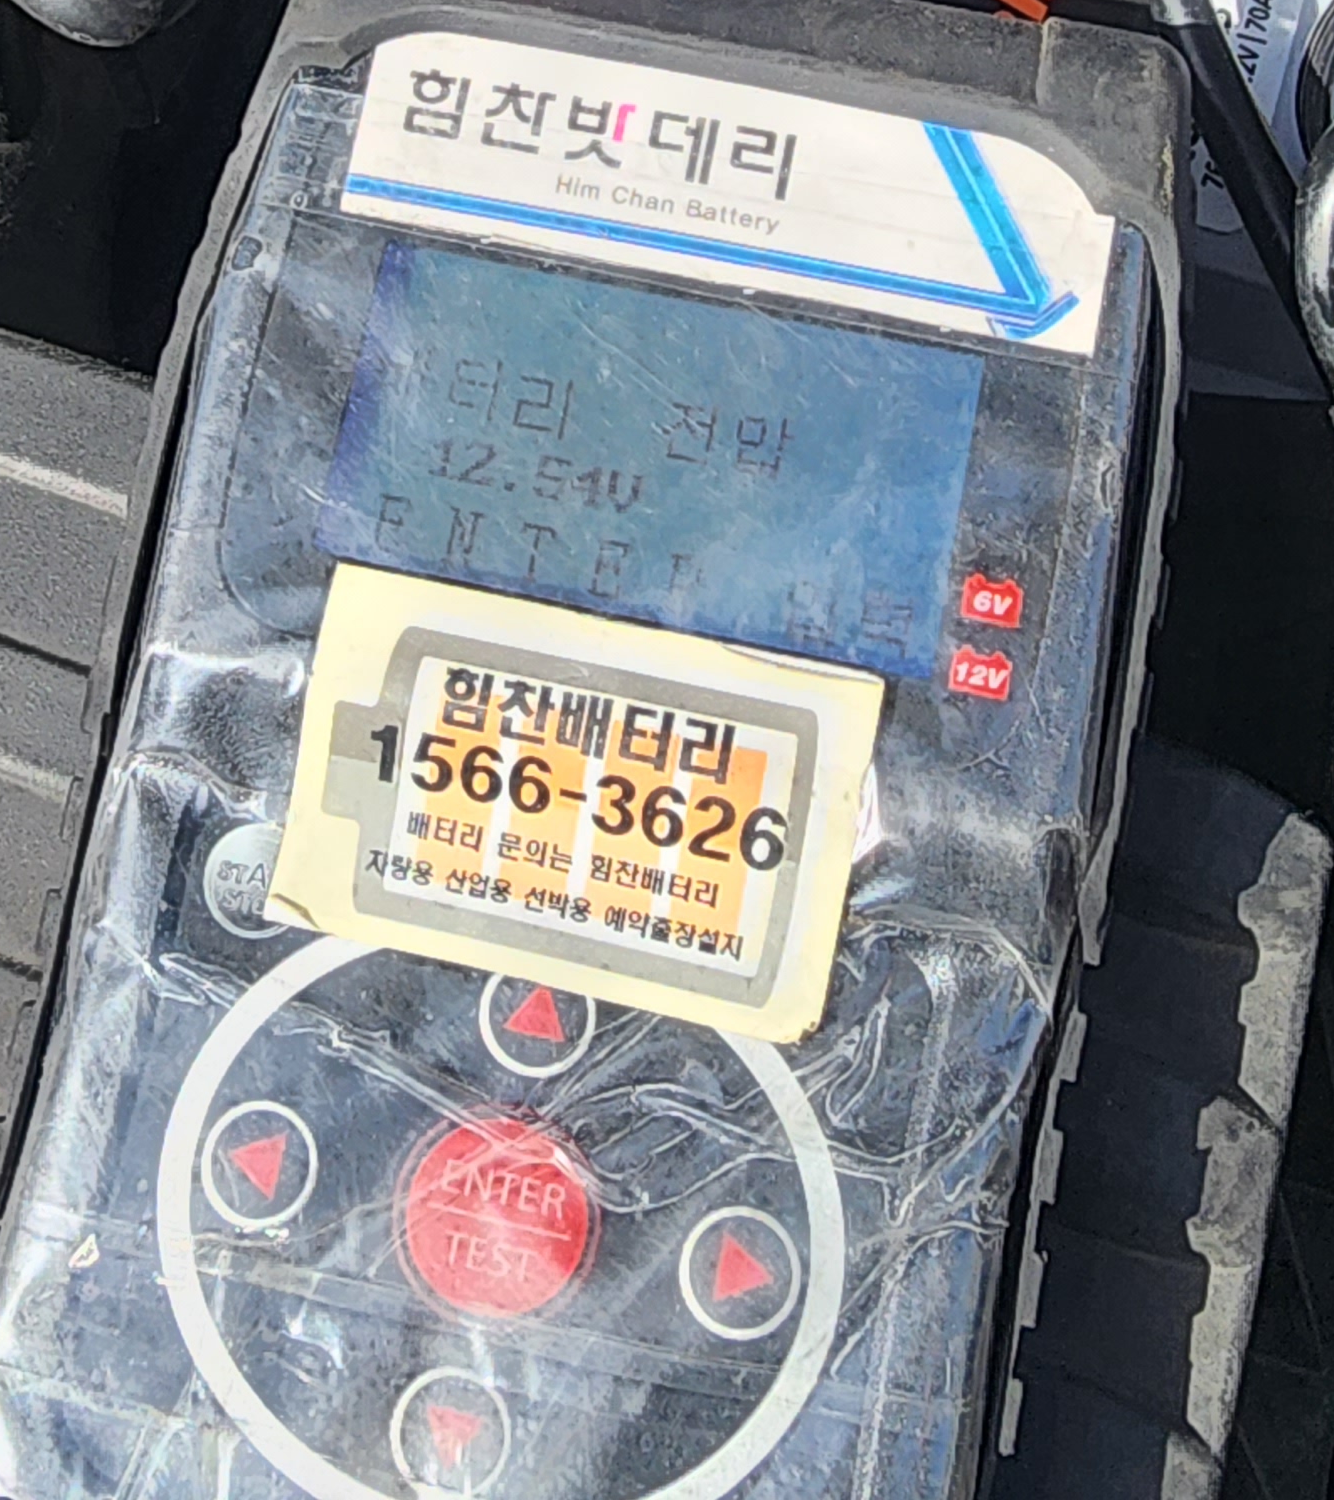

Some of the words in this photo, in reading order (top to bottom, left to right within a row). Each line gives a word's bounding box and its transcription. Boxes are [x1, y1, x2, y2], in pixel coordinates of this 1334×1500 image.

[554, 174, 601, 201] Him
[611, 185, 675, 215] Chan
[684, 199, 781, 237] Battery
[409, 355, 575, 441] 터리
[655, 402, 795, 481] 전압
[972, 592, 1014, 617] 6V
[954, 661, 1010, 690] 12V
[442, 666, 739, 787] 힘찬배터리
[369, 723, 790, 872] 1566-3626
[216, 859, 268, 890] STA
[407, 810, 484, 853] 배터리
[496, 832, 574, 873] 문의는
[589, 853, 720, 908] 힘찬배터리
[444, 868, 513, 905] 산업용
[440, 1156, 567, 1221] ENTER
[445, 1231, 540, 1285] TEST
